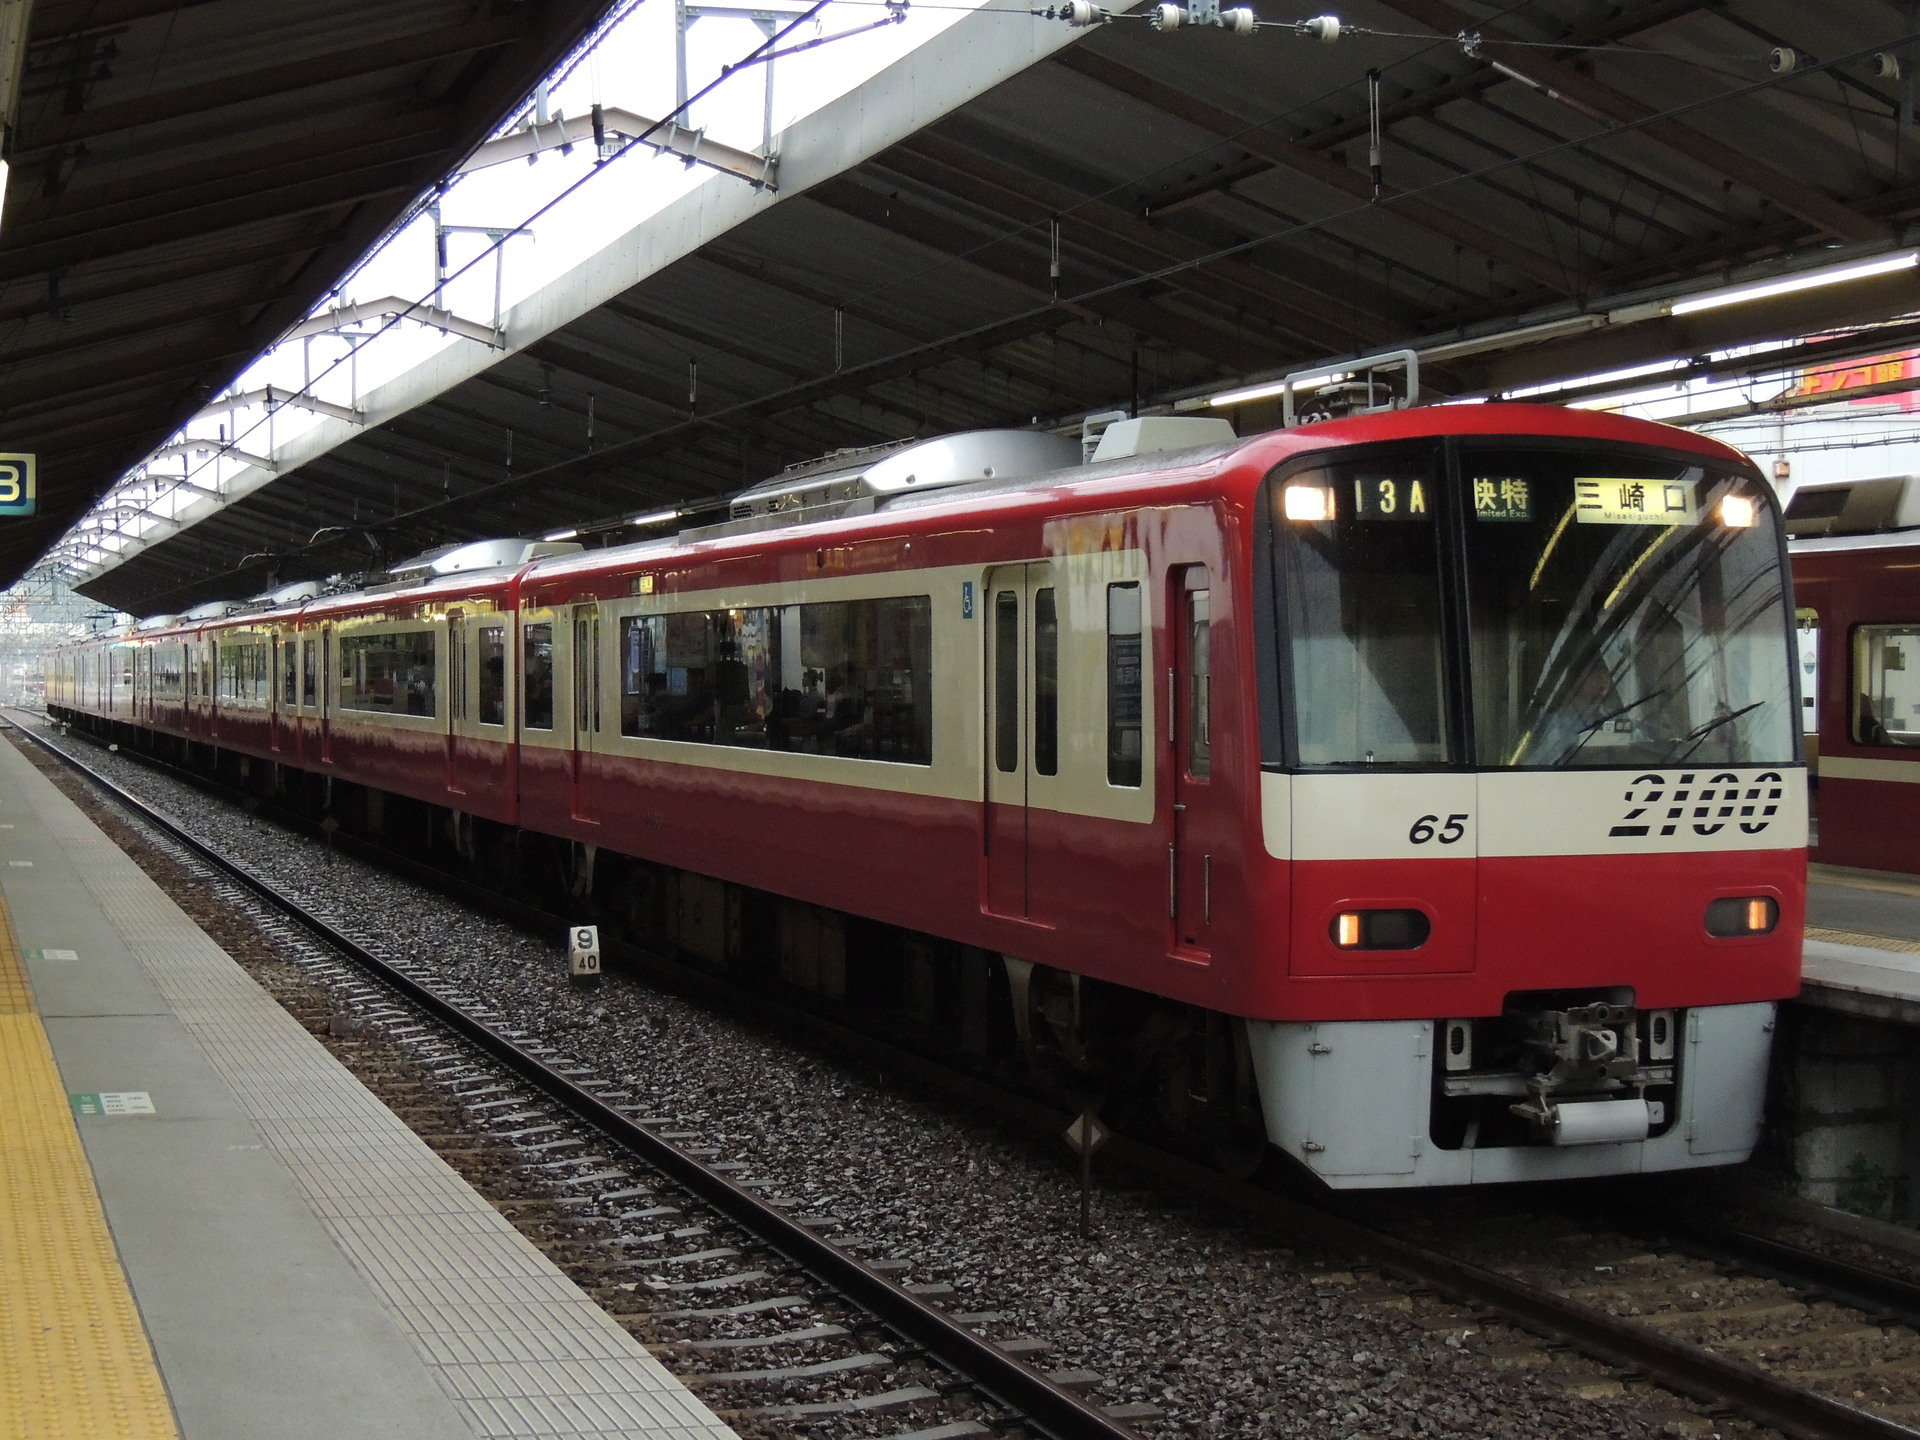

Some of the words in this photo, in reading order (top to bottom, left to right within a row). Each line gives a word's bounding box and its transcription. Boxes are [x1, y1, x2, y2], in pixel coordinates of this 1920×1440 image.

[1473, 477, 1529, 510] 快特
[1577, 482, 1686, 513] 三崎口
[1477, 509, 1507, 518] imited
[1604, 512, 1664, 521] Misakiguchi
[1608, 772, 1782, 837] 2100
[1409, 813, 1469, 845] 65
[577, 928, 593, 949] 9
[578, 954, 597, 970] 40
